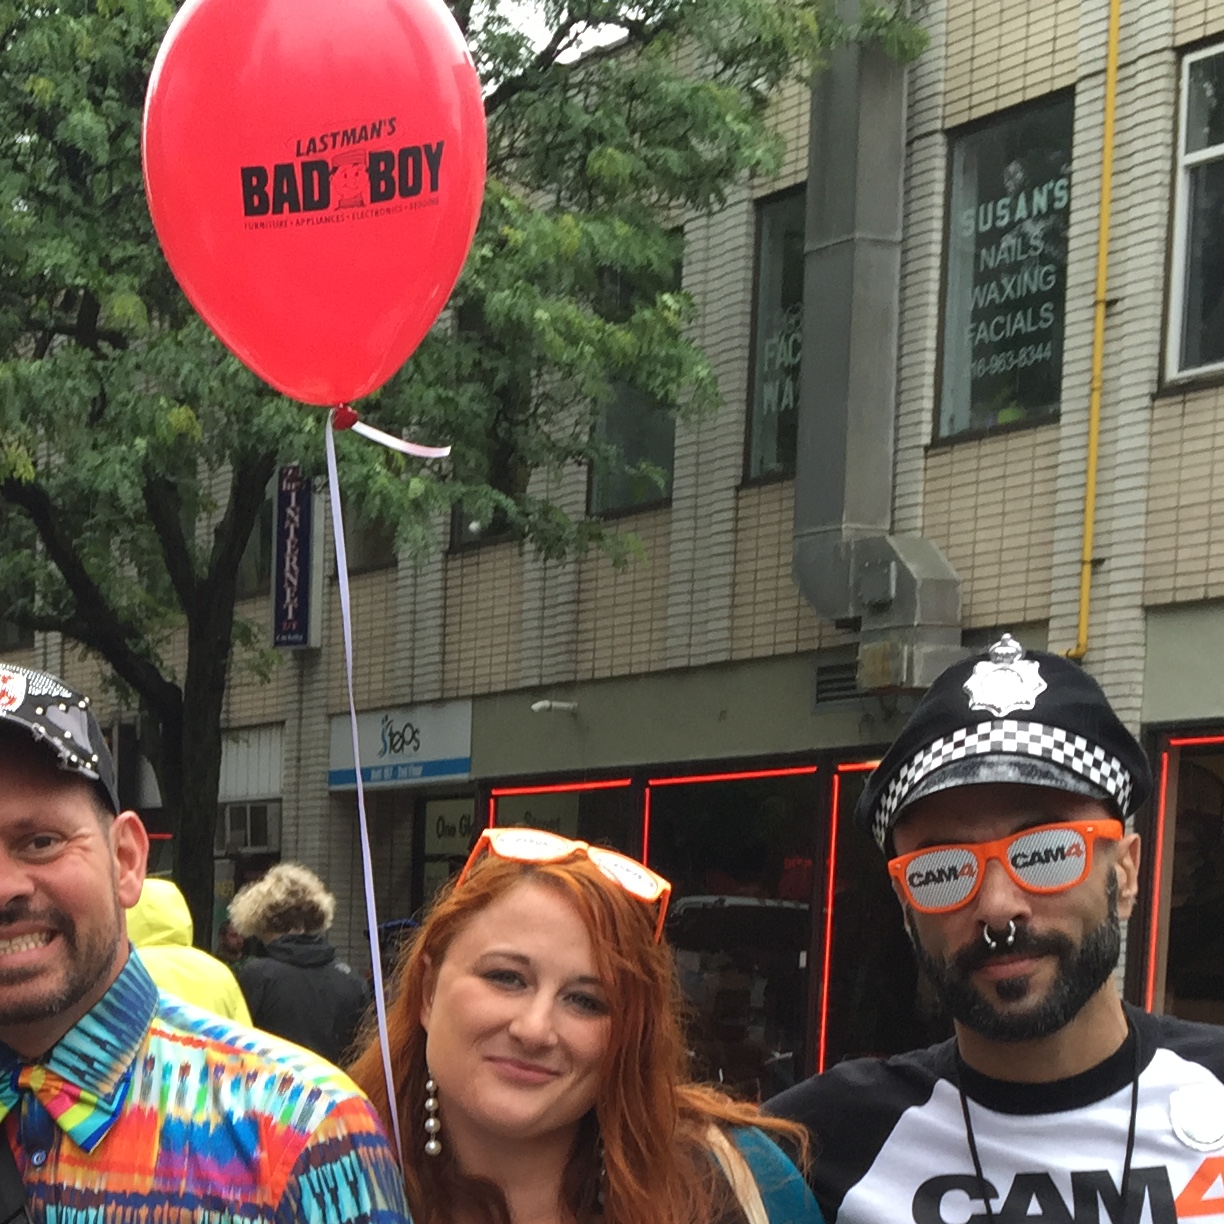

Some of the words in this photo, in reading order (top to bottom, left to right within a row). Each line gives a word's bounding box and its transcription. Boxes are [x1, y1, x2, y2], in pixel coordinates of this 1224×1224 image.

[296, 117, 397, 157] LASTMAN'S
[241, 160, 330, 217] BAD
[369, 141, 445, 204] BOY
[295, 213, 345, 227] APPLIANCES
[960, 178, 1069, 238] SUSAN'S
[980, 229, 1045, 272] NAILS
[964, 301, 1055, 347] FACIALS
[908, 863, 976, 888] CAM4
[1010, 842, 1084, 869] CAM4
